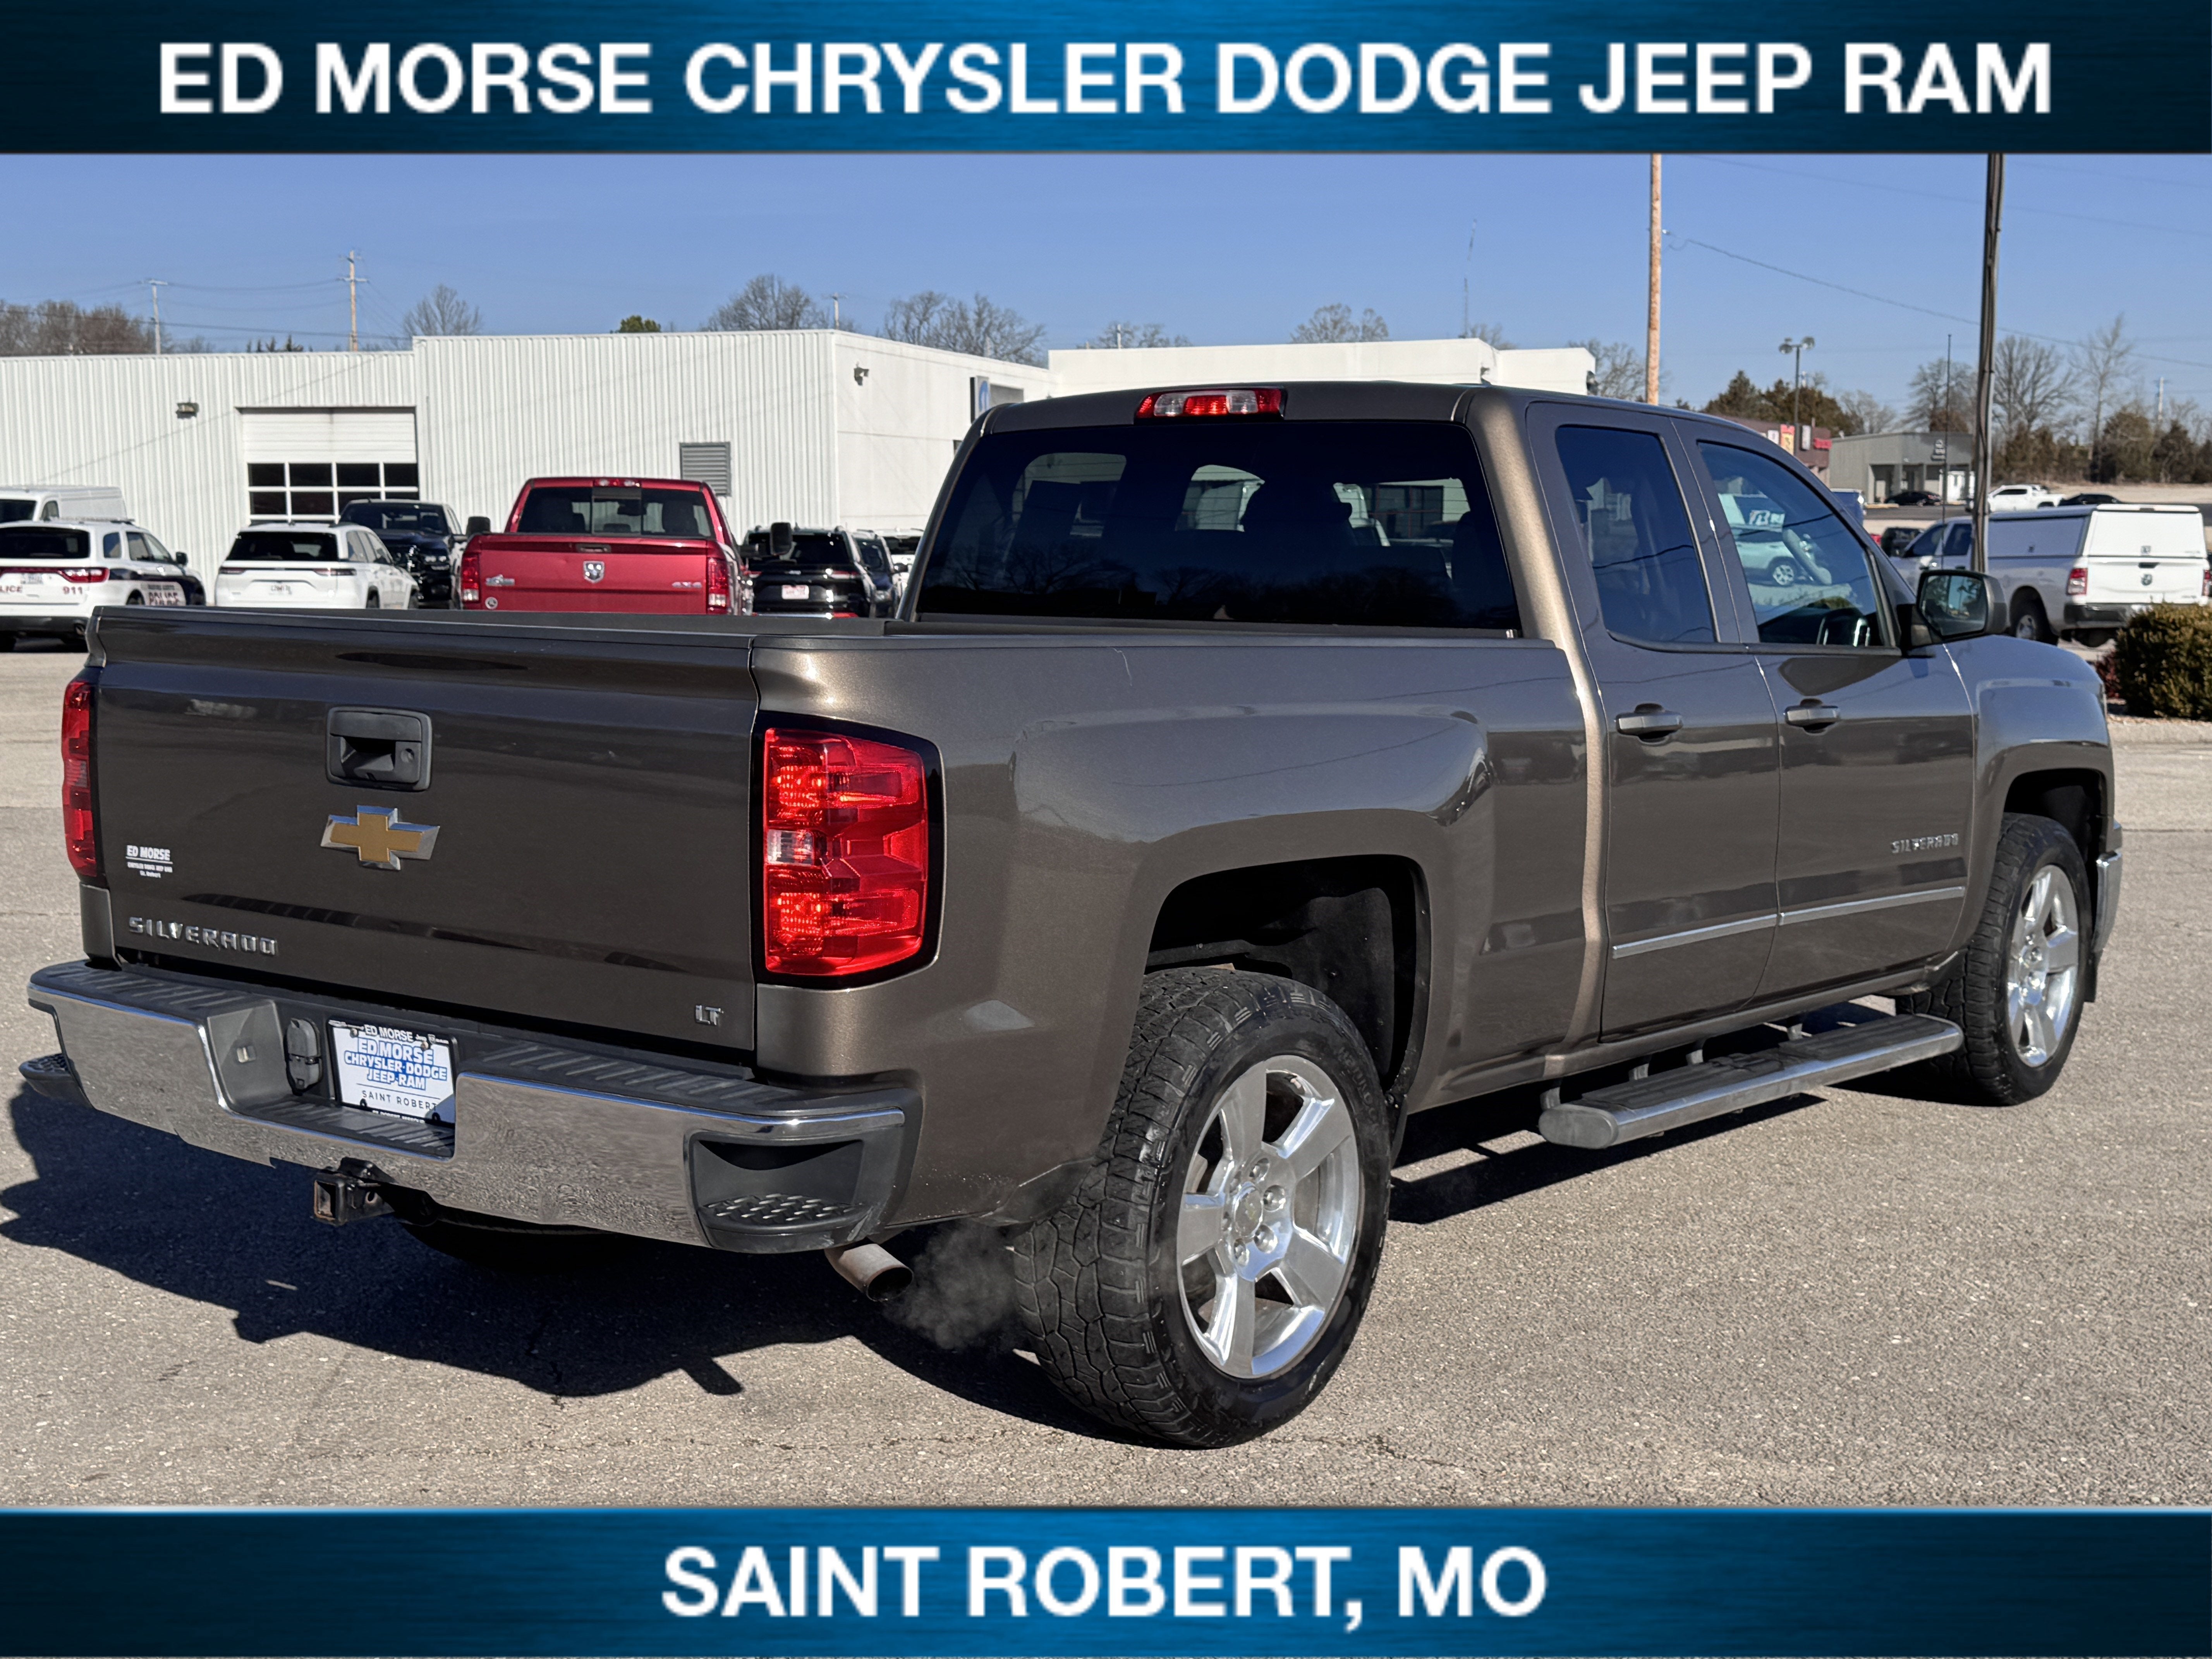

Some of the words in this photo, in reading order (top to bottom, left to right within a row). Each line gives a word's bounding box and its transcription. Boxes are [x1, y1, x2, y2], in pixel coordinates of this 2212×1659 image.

[62, 586, 83, 595] 911
[127, 845, 139, 857] ED
[140, 846, 170, 861] MORSE
[1891, 833, 1958, 854] SILVERADO
[129, 917, 276, 956] SILVERADO
[696, 1005, 722, 1026] LT
[364, 1024, 378, 1036] ED
[379, 1027, 414, 1042] MORSE
[358, 1038, 378, 1055] ED
[379, 1041, 434, 1065] MORSE
[362, 1090, 391, 1102] SAINT
[397, 1096, 437, 1111] ROBERT
